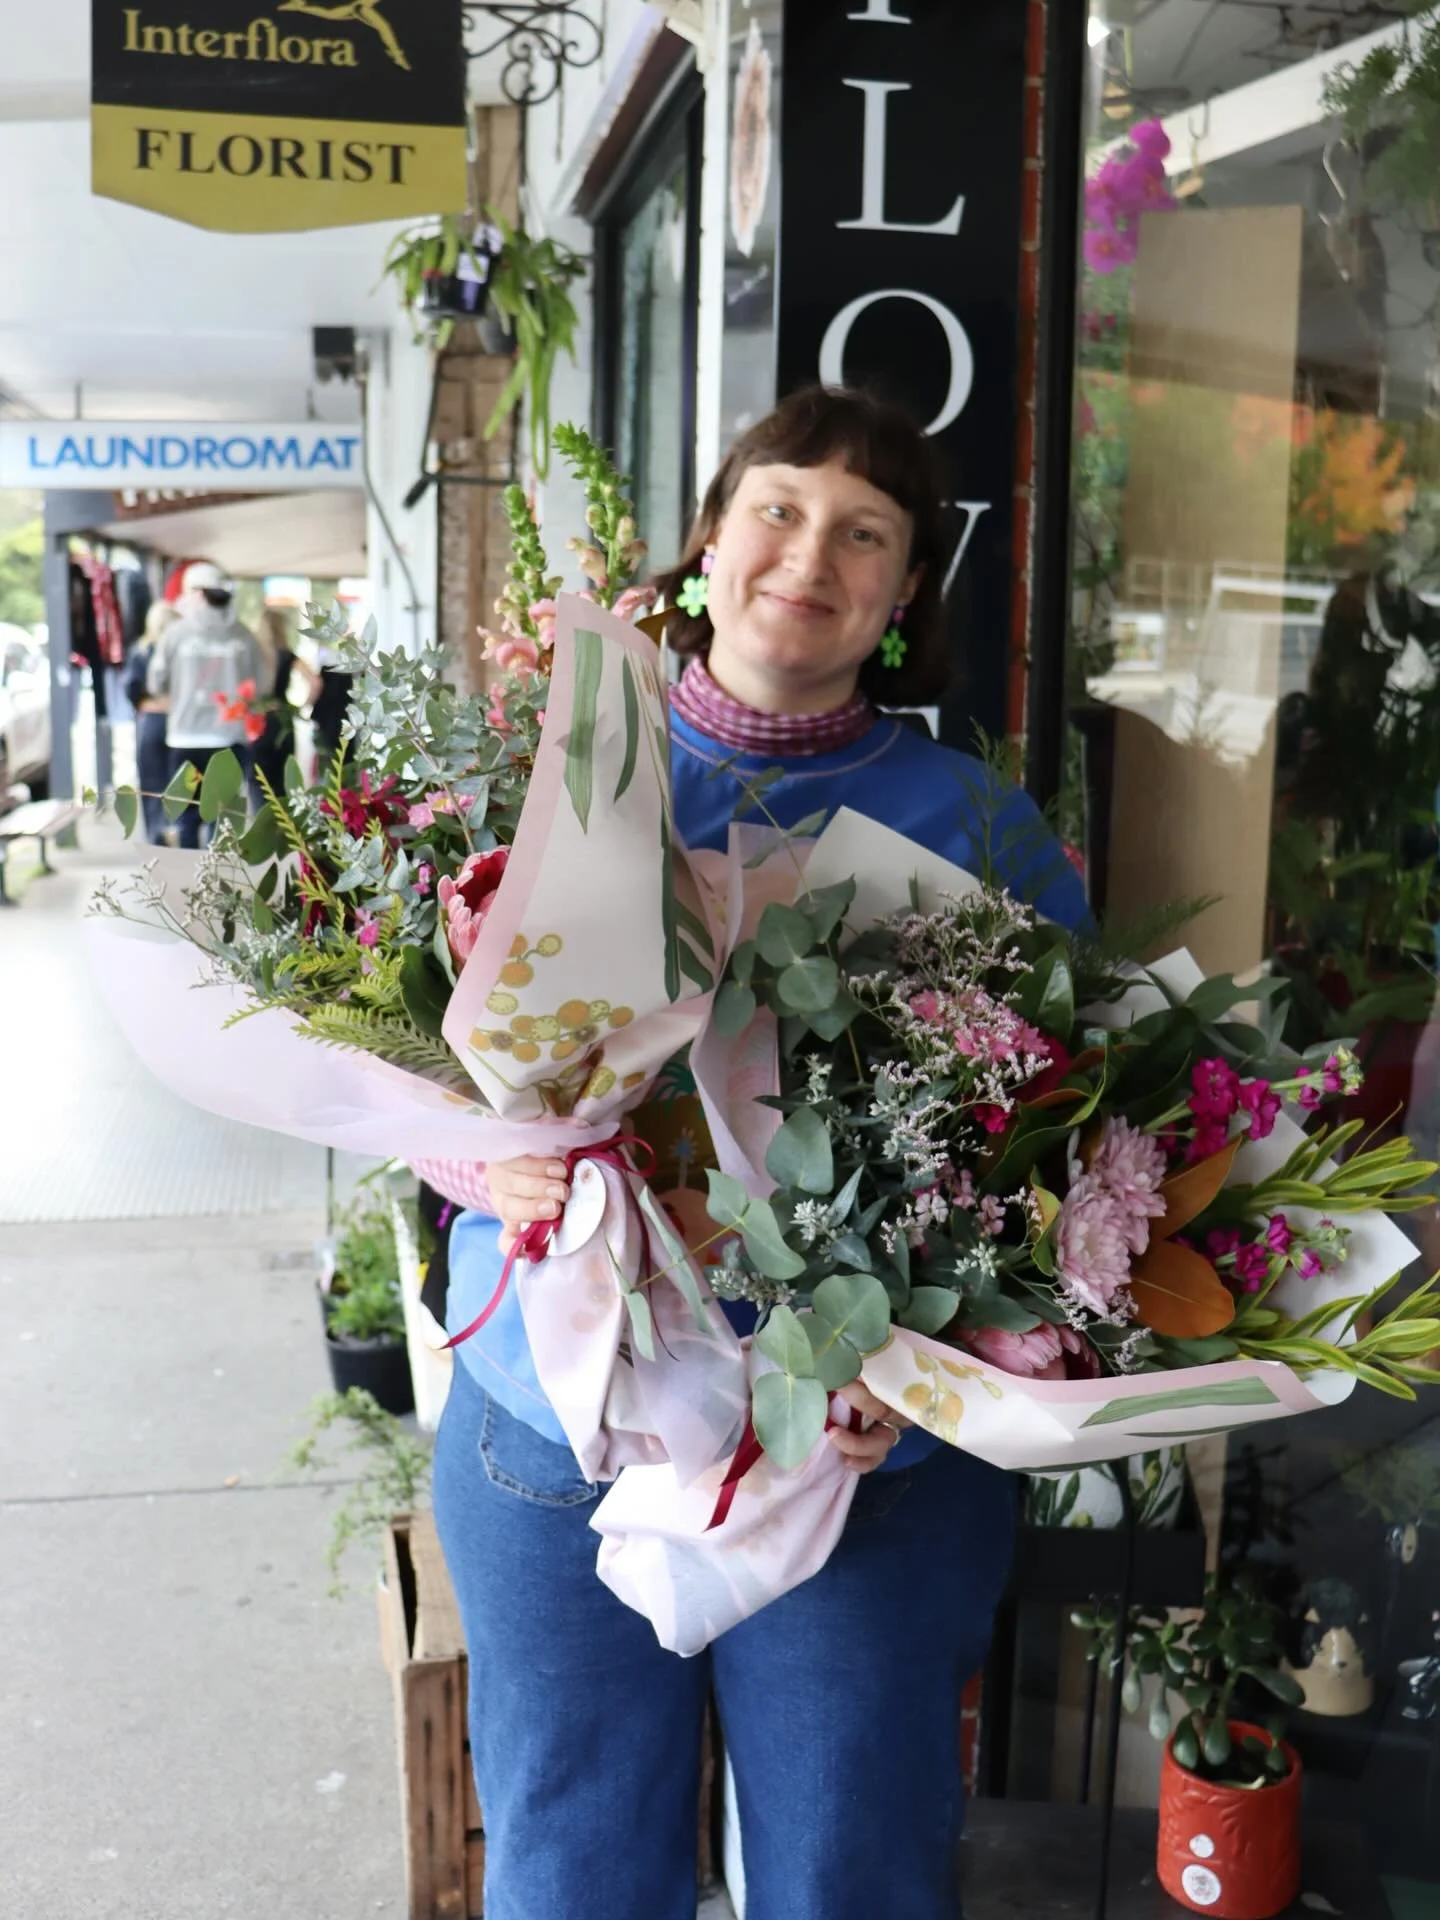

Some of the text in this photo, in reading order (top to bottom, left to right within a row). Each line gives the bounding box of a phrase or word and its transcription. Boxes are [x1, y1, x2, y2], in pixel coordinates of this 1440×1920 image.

[122, 9, 358, 67] Interflora
[135, 127, 416, 185] FLORIST
[28, 436, 360, 470] LAUNDROMAT
